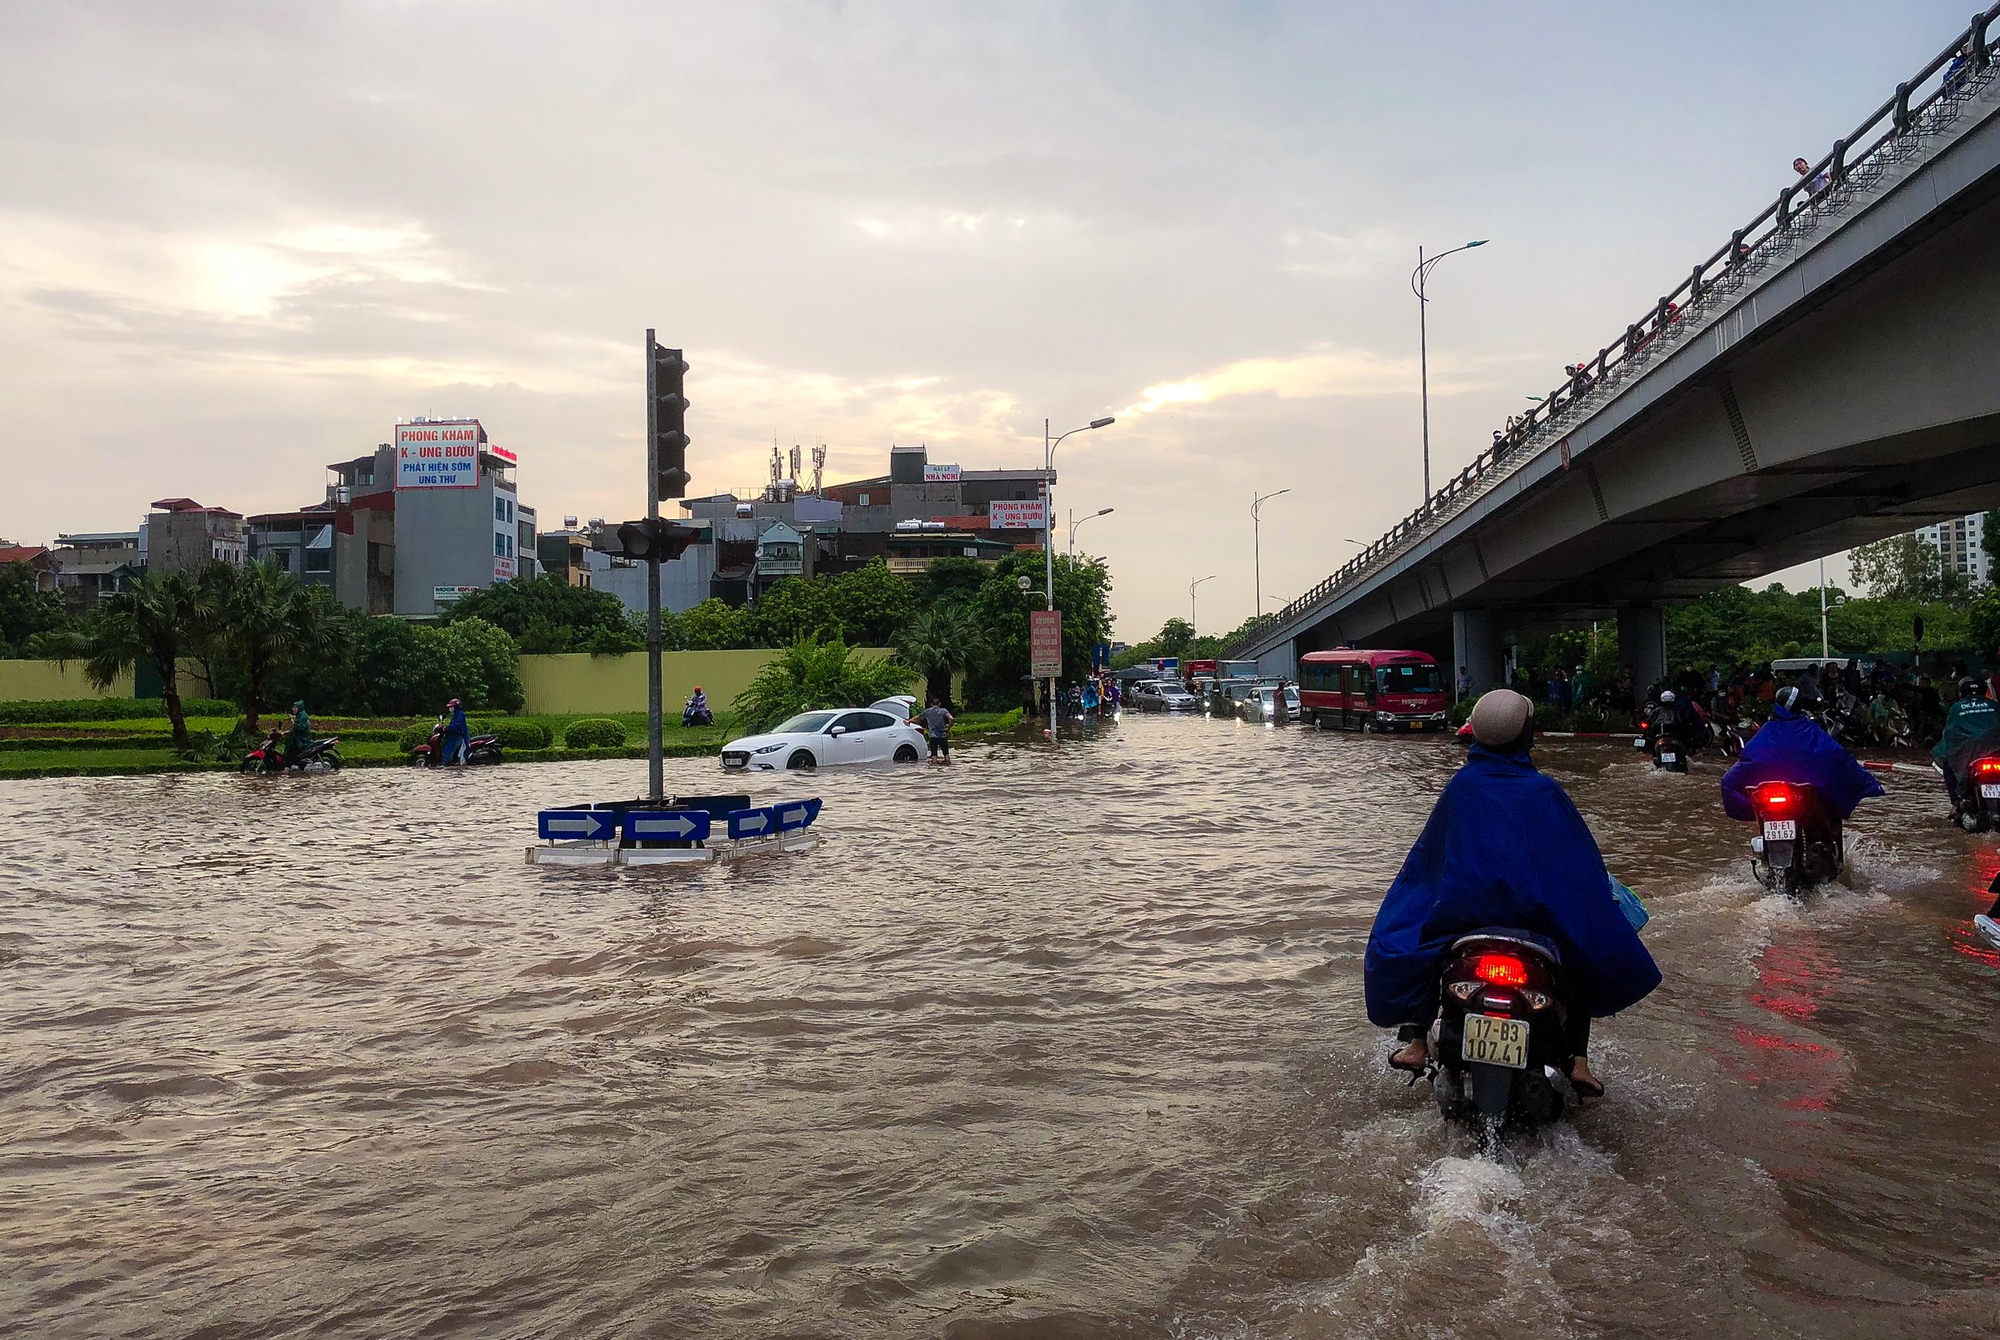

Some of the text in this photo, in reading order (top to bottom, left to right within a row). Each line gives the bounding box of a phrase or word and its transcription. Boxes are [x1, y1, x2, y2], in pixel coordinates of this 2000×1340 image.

[401, 447, 408, 458] K
[1766, 830, 1794, 839] 291.62
[1475, 1019, 1519, 1042] 17-B3
[1468, 1039, 1522, 1065] 107.41
